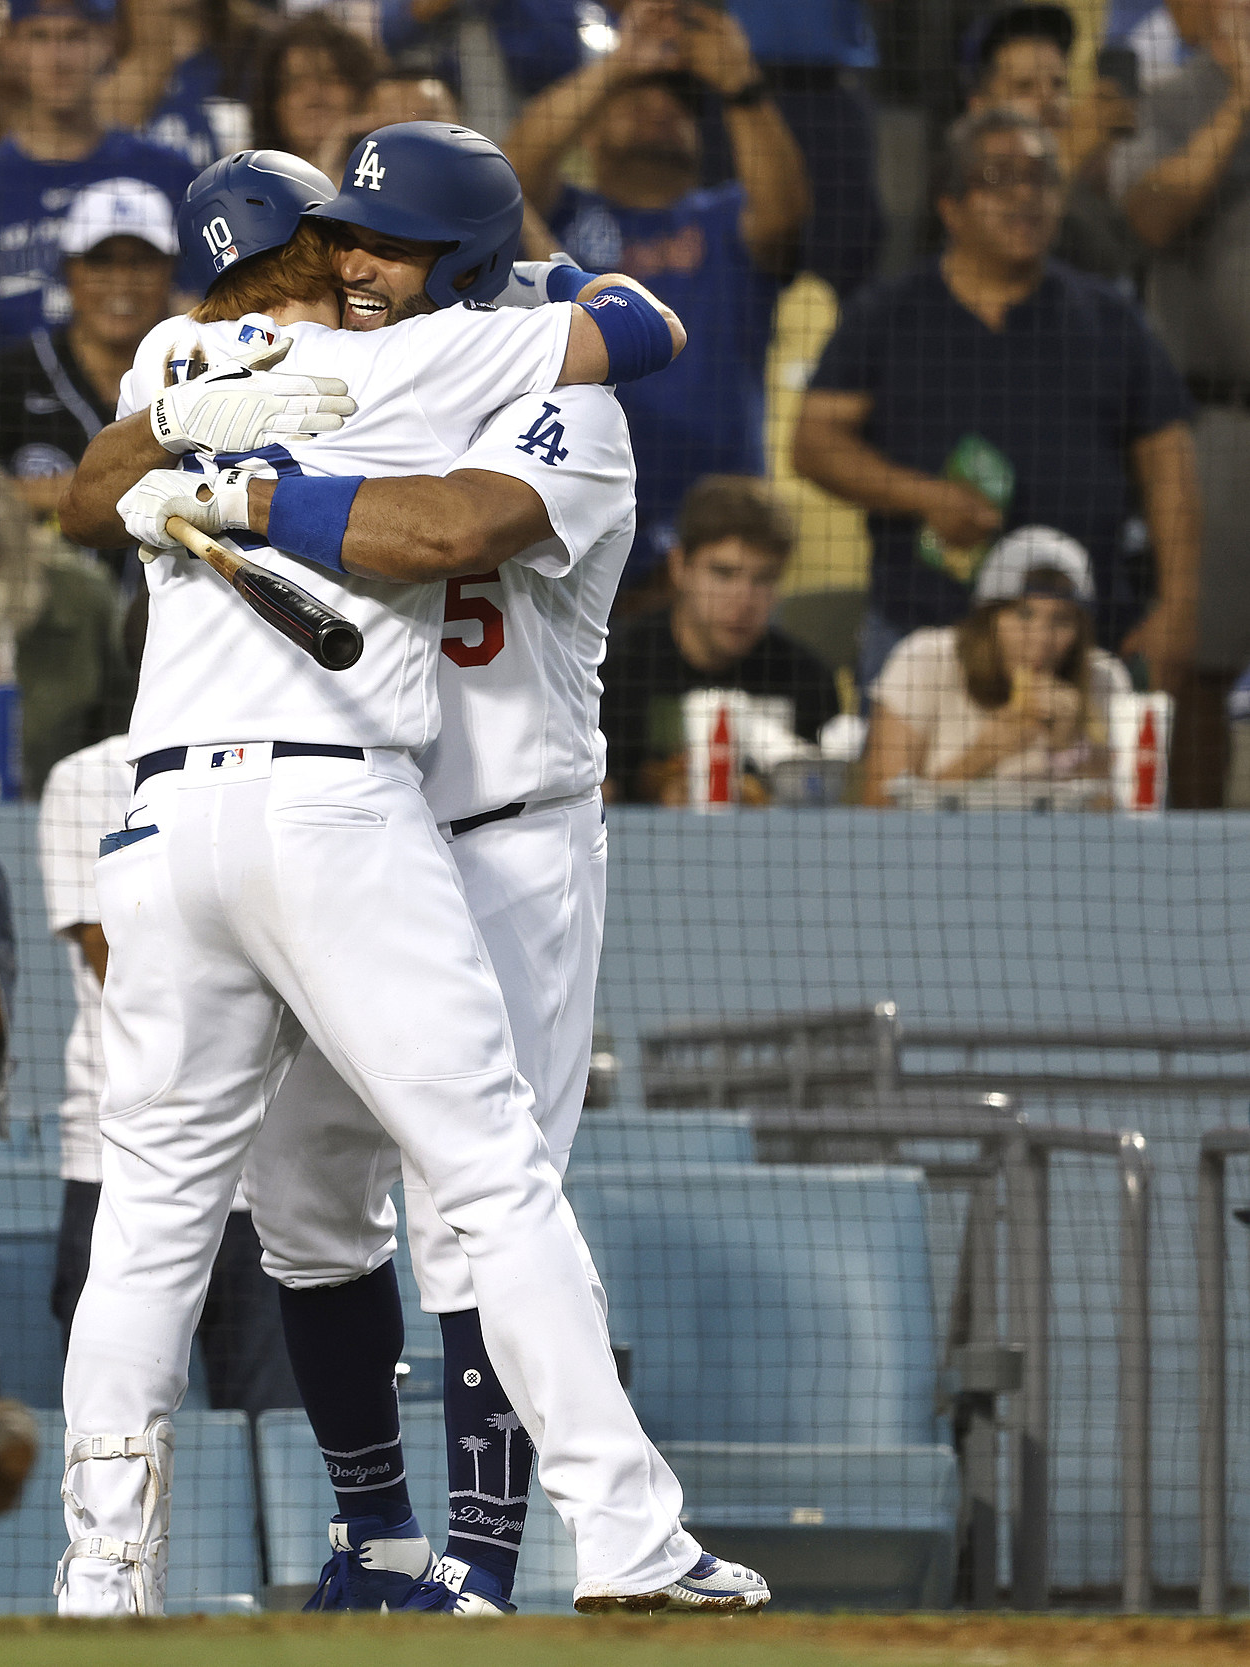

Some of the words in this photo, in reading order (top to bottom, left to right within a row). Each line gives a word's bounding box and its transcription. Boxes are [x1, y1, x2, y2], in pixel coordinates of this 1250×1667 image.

[353, 140, 386, 191] LA
[202, 216, 233, 256] 10
[156, 398, 170, 435] PUJOLS
[514, 401, 569, 467] LA
[326, 1460, 391, 1484] Dodgers
[457, 1505, 524, 1536] Dodgers
